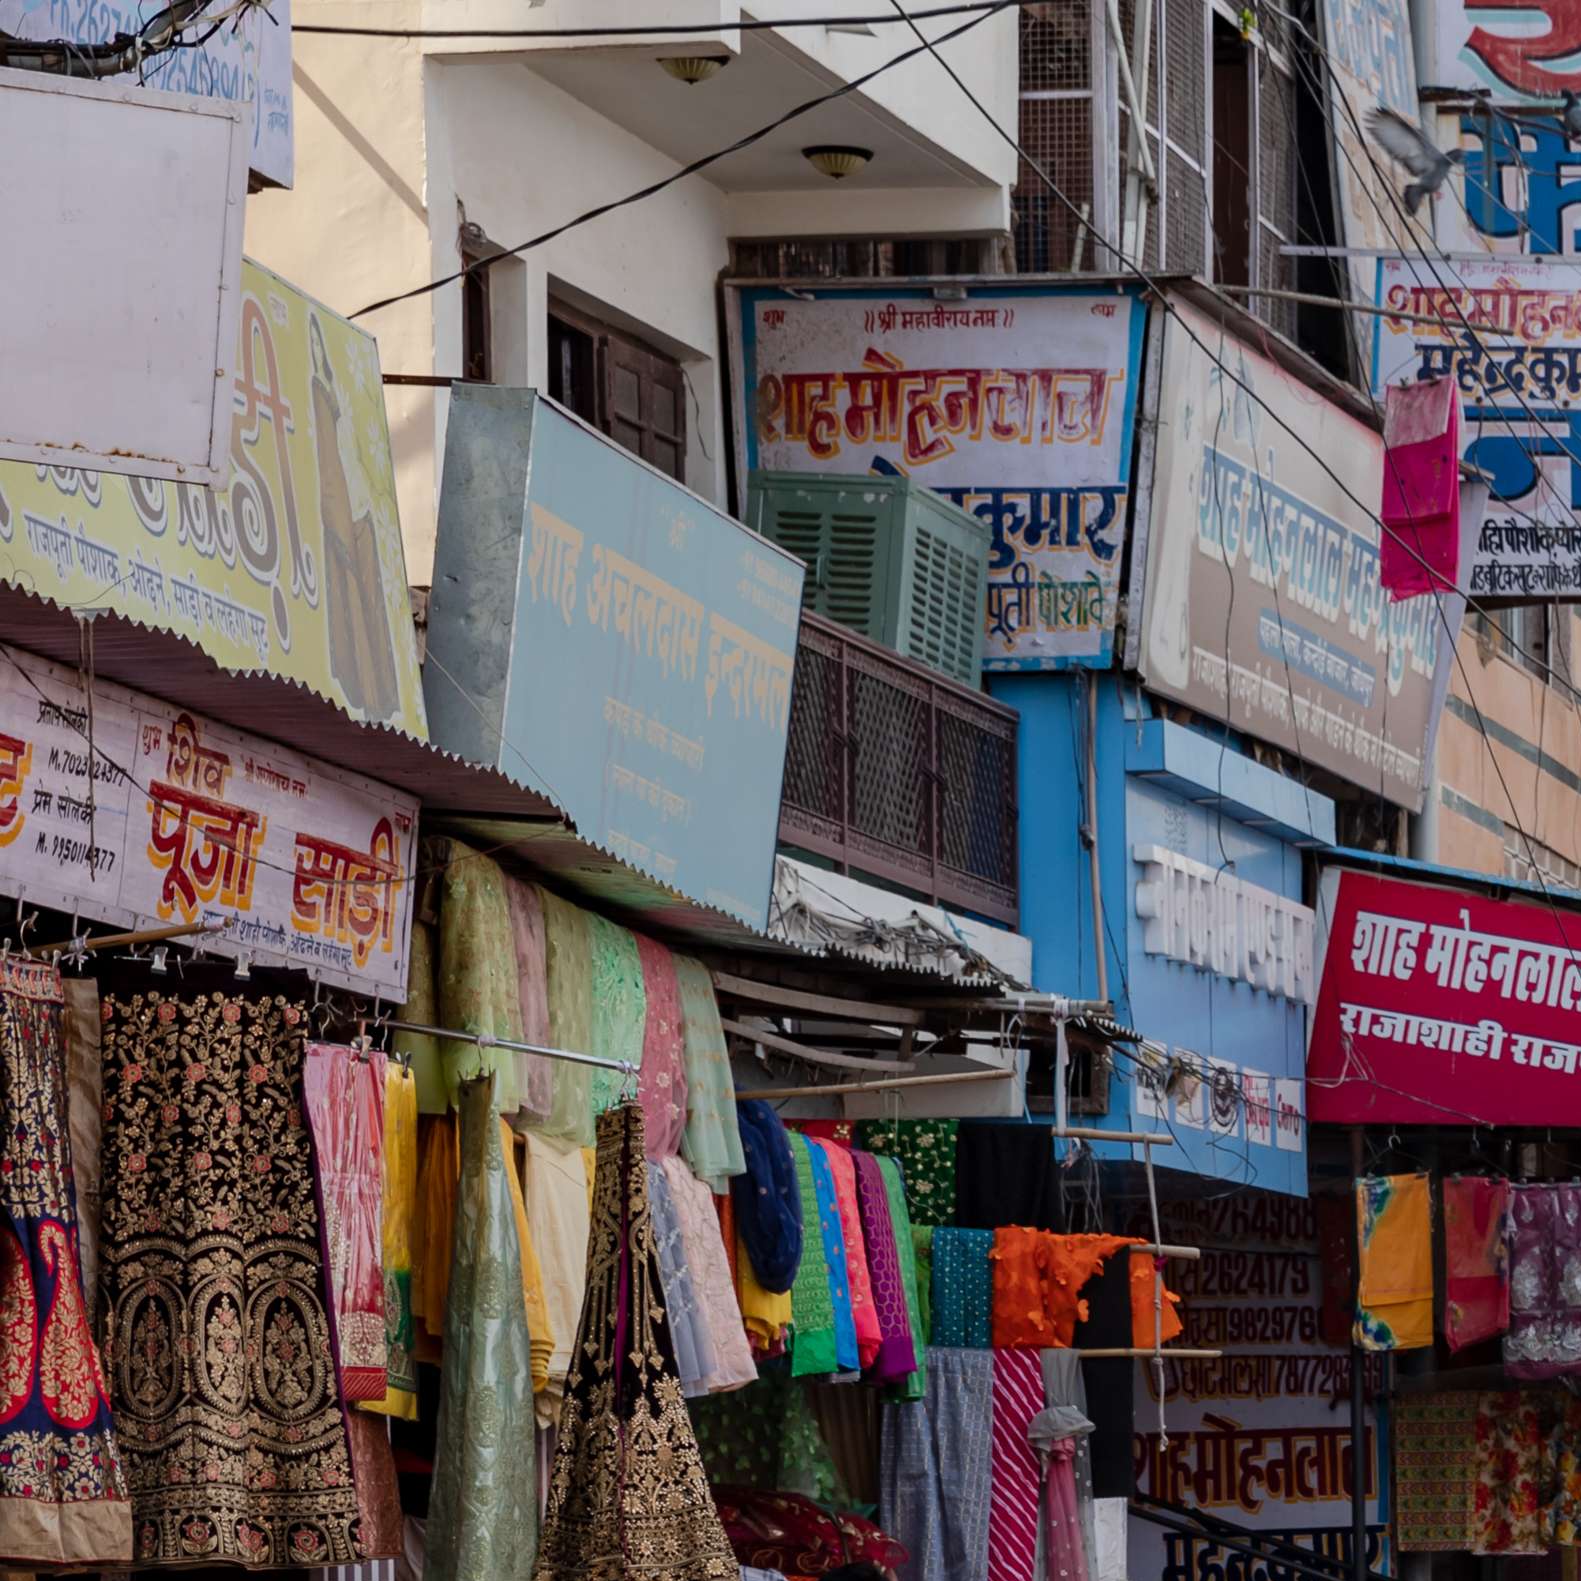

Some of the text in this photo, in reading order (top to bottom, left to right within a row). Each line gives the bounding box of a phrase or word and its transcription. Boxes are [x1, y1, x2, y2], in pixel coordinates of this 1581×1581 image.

[147, 778, 267, 924] पूजा
[1351, 910, 1426, 981] शाह
[1340, 1002, 1508, 1060] राजाशाही
